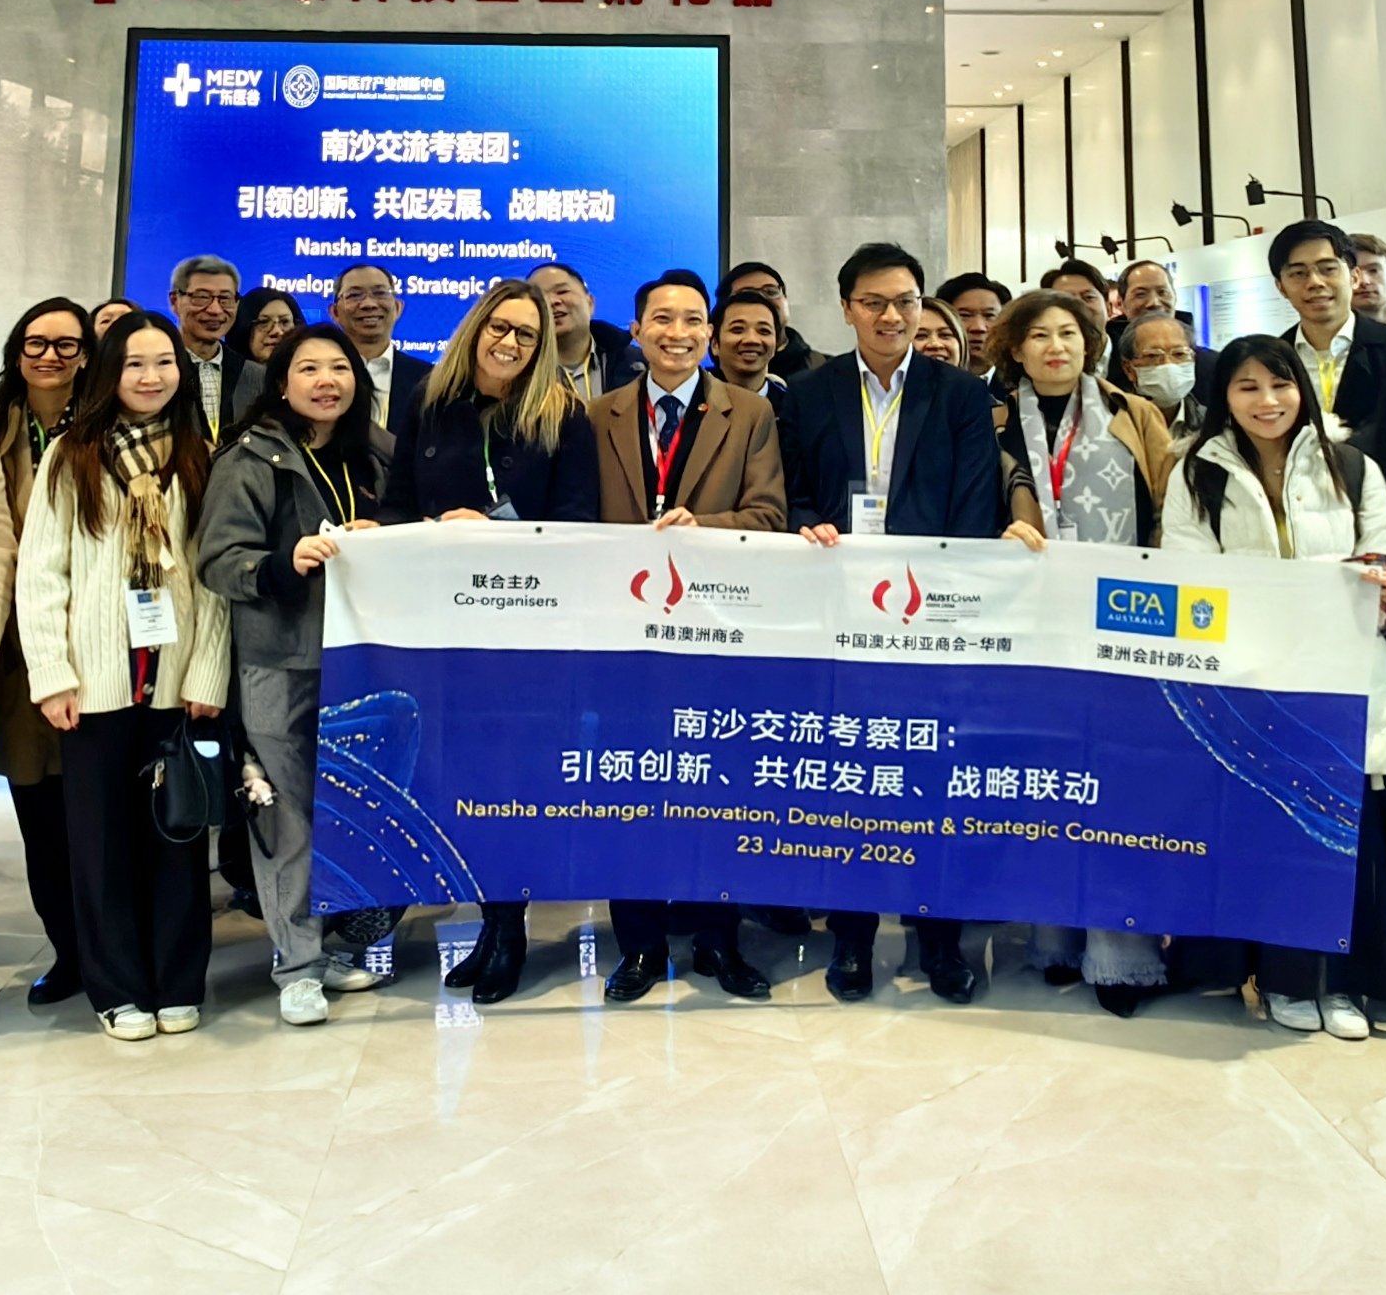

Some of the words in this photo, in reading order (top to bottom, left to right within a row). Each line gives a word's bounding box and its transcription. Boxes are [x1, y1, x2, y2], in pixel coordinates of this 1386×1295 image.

[206, 69, 263, 87] MEDV
[323, 75, 446, 93] 国际医疗产业创新中心
[206, 89, 261, 107] 广东医谷
[238, 186, 615, 223] 引领创新、共促发展、战略联动
[295, 237, 361, 257] Nansha
[367, 238, 454, 262] Exchange:
[459, 238, 557, 261] Innovation,
[263, 274, 335, 298] Develop
[407, 275, 485, 299] Strategic
[402, 339, 436, 353] January
[472, 574, 541, 590] 联合主办
[454, 592, 559, 610] Co-organisers
[1108, 589, 1164, 616] CPA
[1107, 613, 1166, 627] AUSTRALIA
[644, 623, 745, 644] 香港澳洲商会
[561, 749, 1100, 805] 引领创新、共促发展、战略联动
[456, 799, 537, 818] Nansha
[544, 800, 656, 822] exchange:
[663, 801, 780, 826] Innovation,
[788, 807, 935, 835] Development
[940, 817, 956, 835] &
[963, 817, 1059, 841] Strategic
[1065, 822, 1208, 856] Connections
[736, 835, 764, 854] 23
[770, 837, 854, 864] January
[860, 843, 916, 865] 2026
